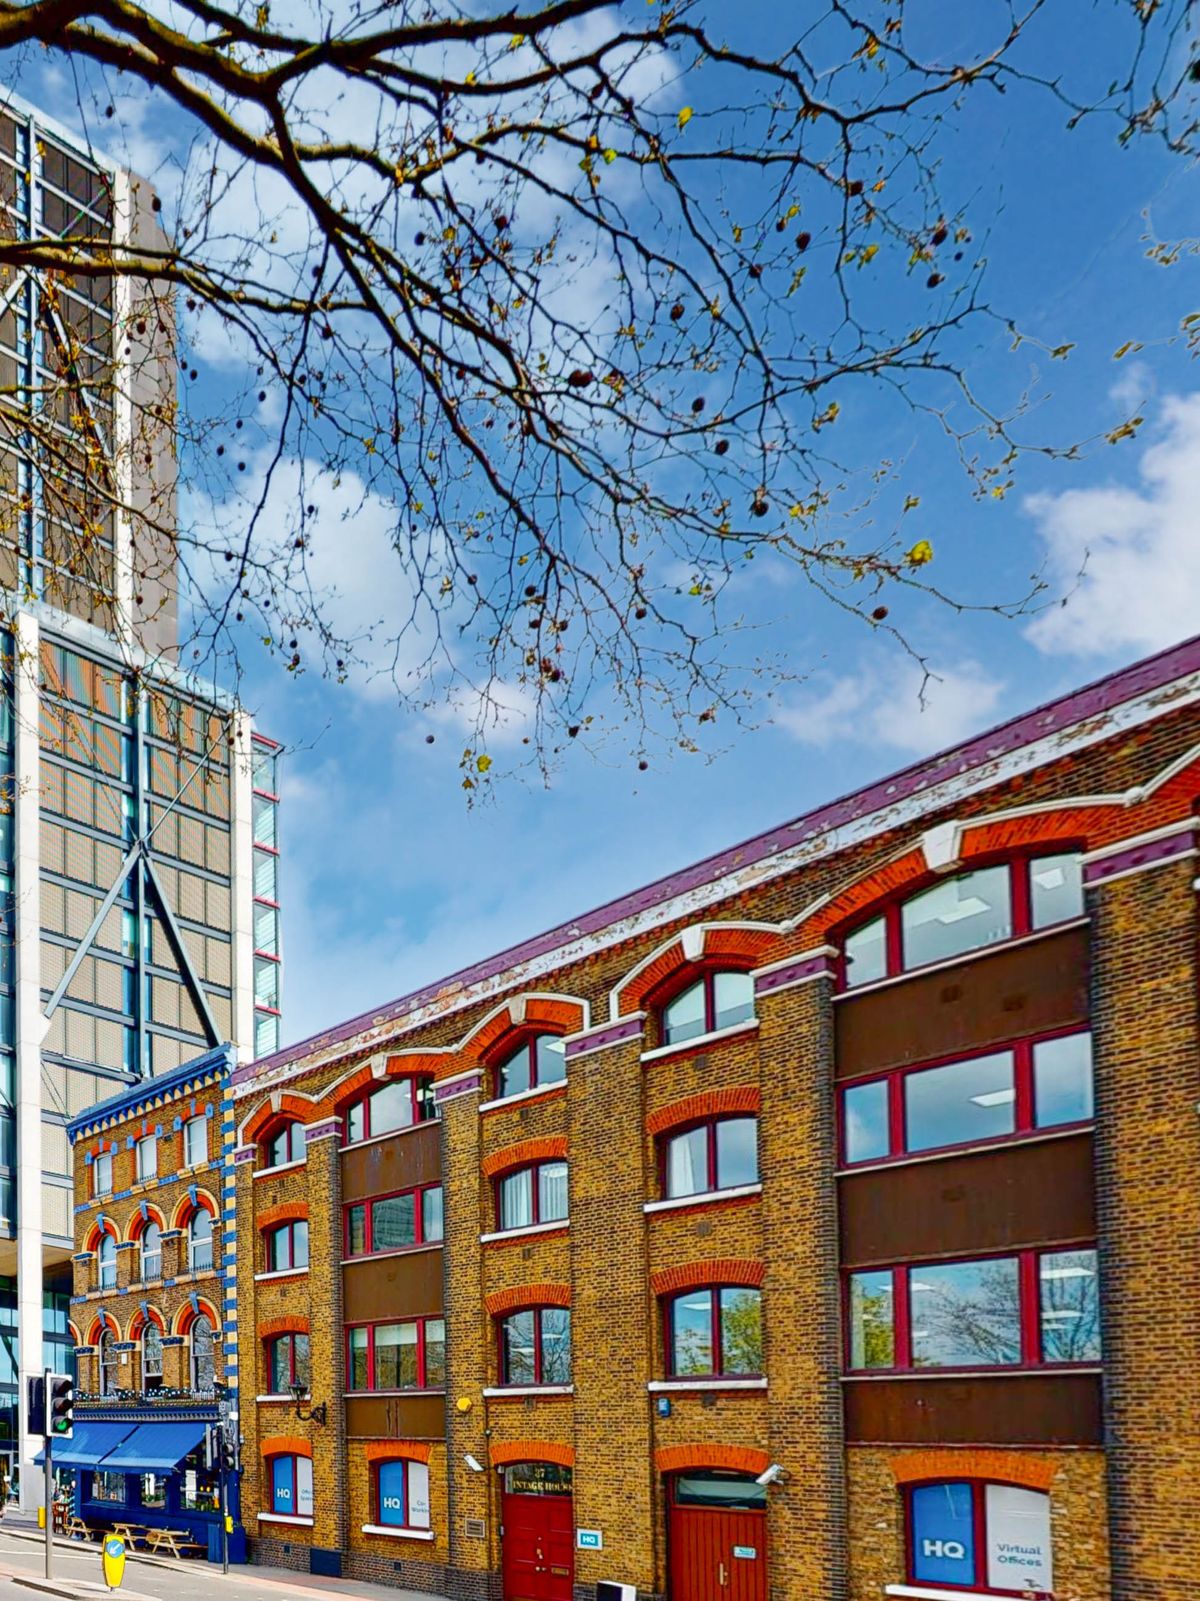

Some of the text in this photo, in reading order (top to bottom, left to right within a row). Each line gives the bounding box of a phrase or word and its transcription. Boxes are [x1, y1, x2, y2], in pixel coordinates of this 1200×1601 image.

[276, 1487, 290, 1499] HQ
[383, 1497, 400, 1509] HQ
[582, 1535, 596, 1544] HQ
[923, 1539, 965, 1560] HQ
[997, 1544, 1042, 1555] Virtual
[997, 1555, 1042, 1567] Offices
